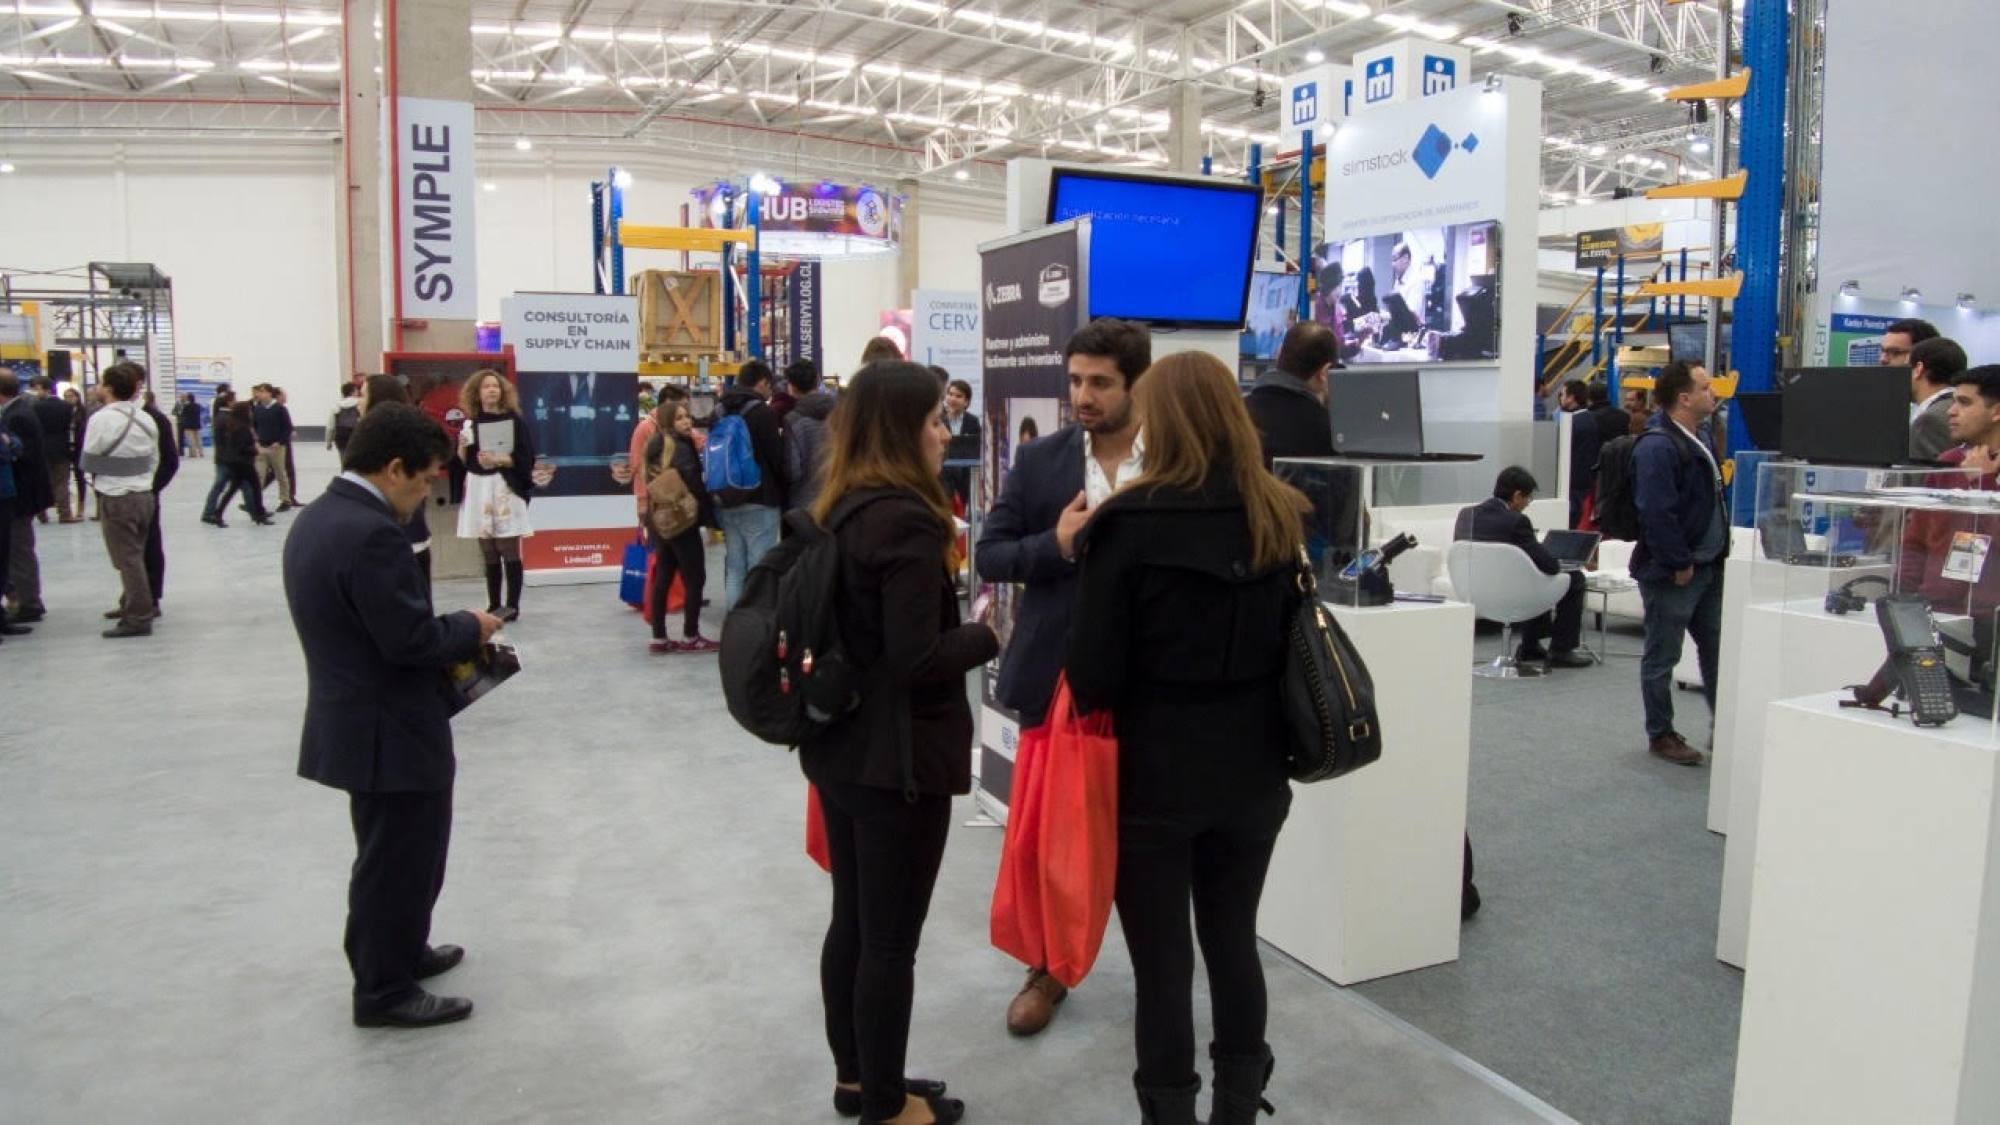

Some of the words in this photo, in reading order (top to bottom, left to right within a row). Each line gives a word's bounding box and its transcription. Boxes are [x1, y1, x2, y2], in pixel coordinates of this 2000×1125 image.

[1343, 150, 1408, 176] slimstock
[412, 124, 453, 302] SYMPLE
[997, 283, 1022, 304] ZEBRA
[524, 310, 629, 324] CONSULTORÍA
[929, 313, 978, 331] CERV
[567, 325, 588, 336] EN
[525, 338, 580, 349] SUPPLY
[584, 339, 631, 350] CHAIN
[1027, 351, 1062, 366] inventario
